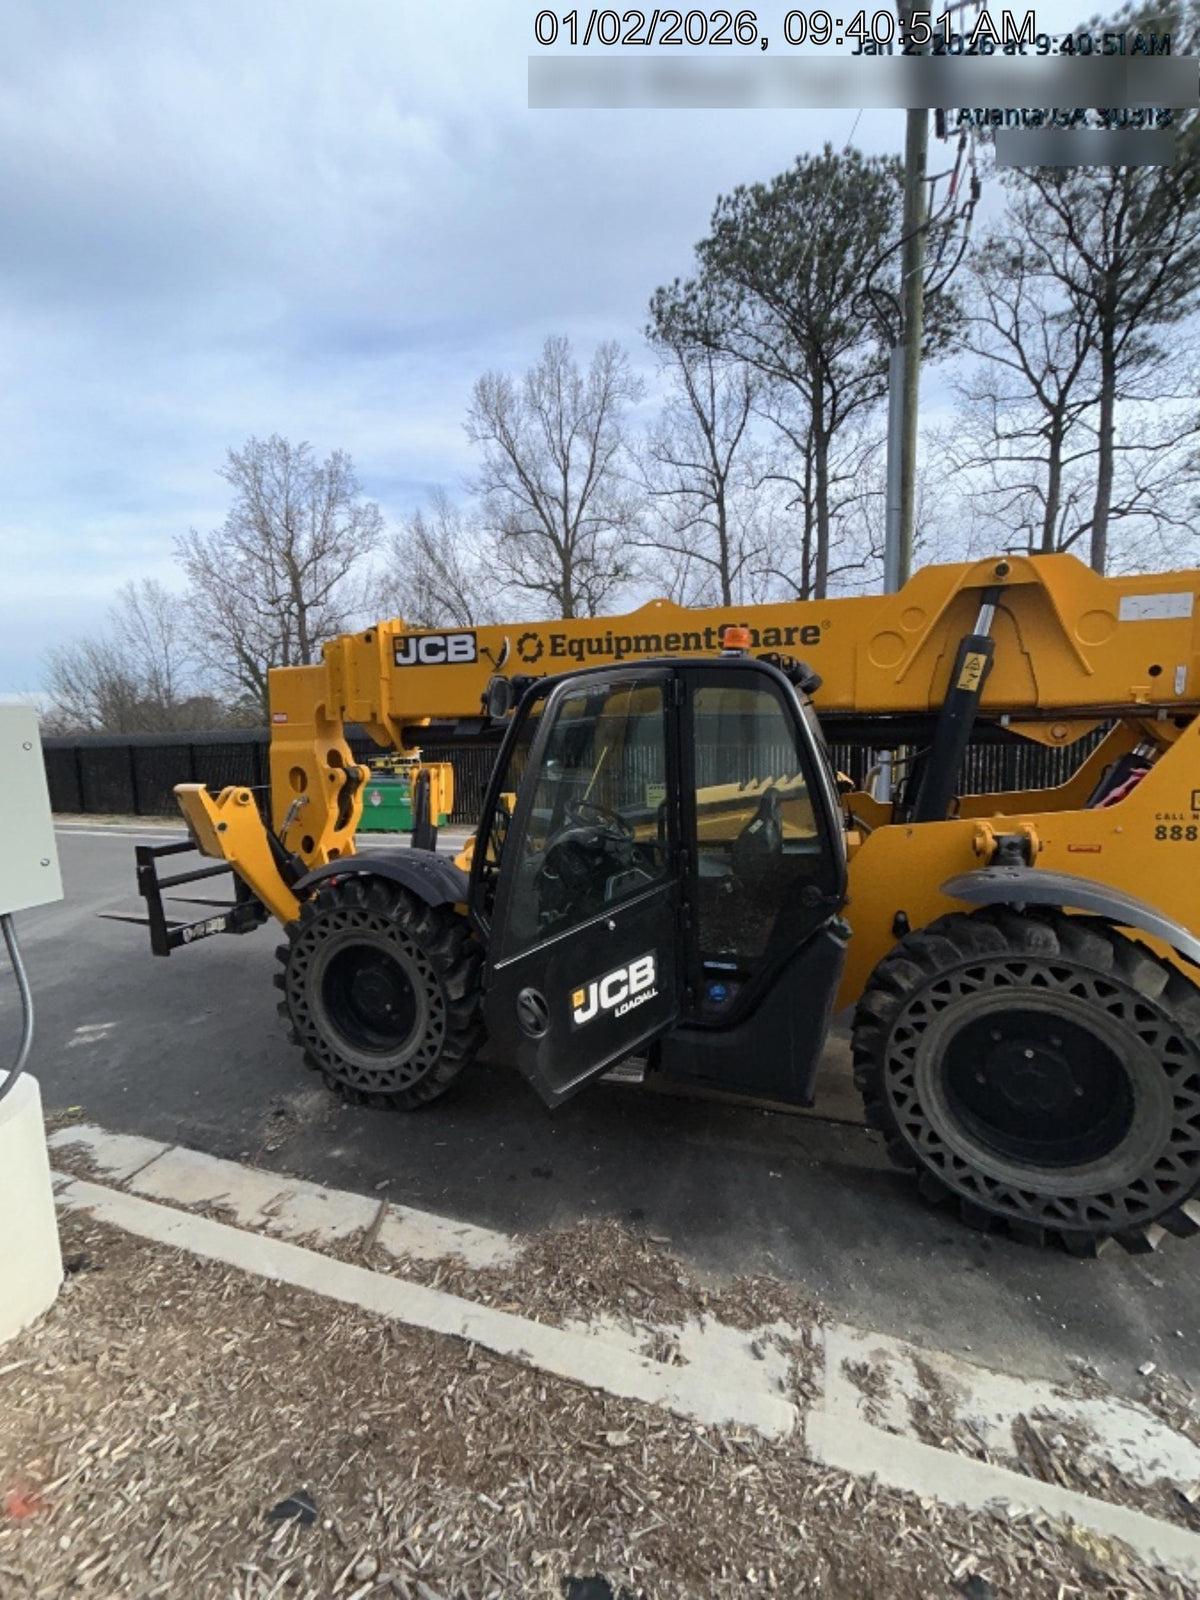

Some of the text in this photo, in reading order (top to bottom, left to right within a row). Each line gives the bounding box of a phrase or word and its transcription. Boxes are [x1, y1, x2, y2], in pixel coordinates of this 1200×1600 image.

[395, 634, 476, 665] JCB
[1155, 825, 1198, 841] 888
[573, 956, 655, 1024] JCB
[614, 988, 658, 1018] LOADALL
